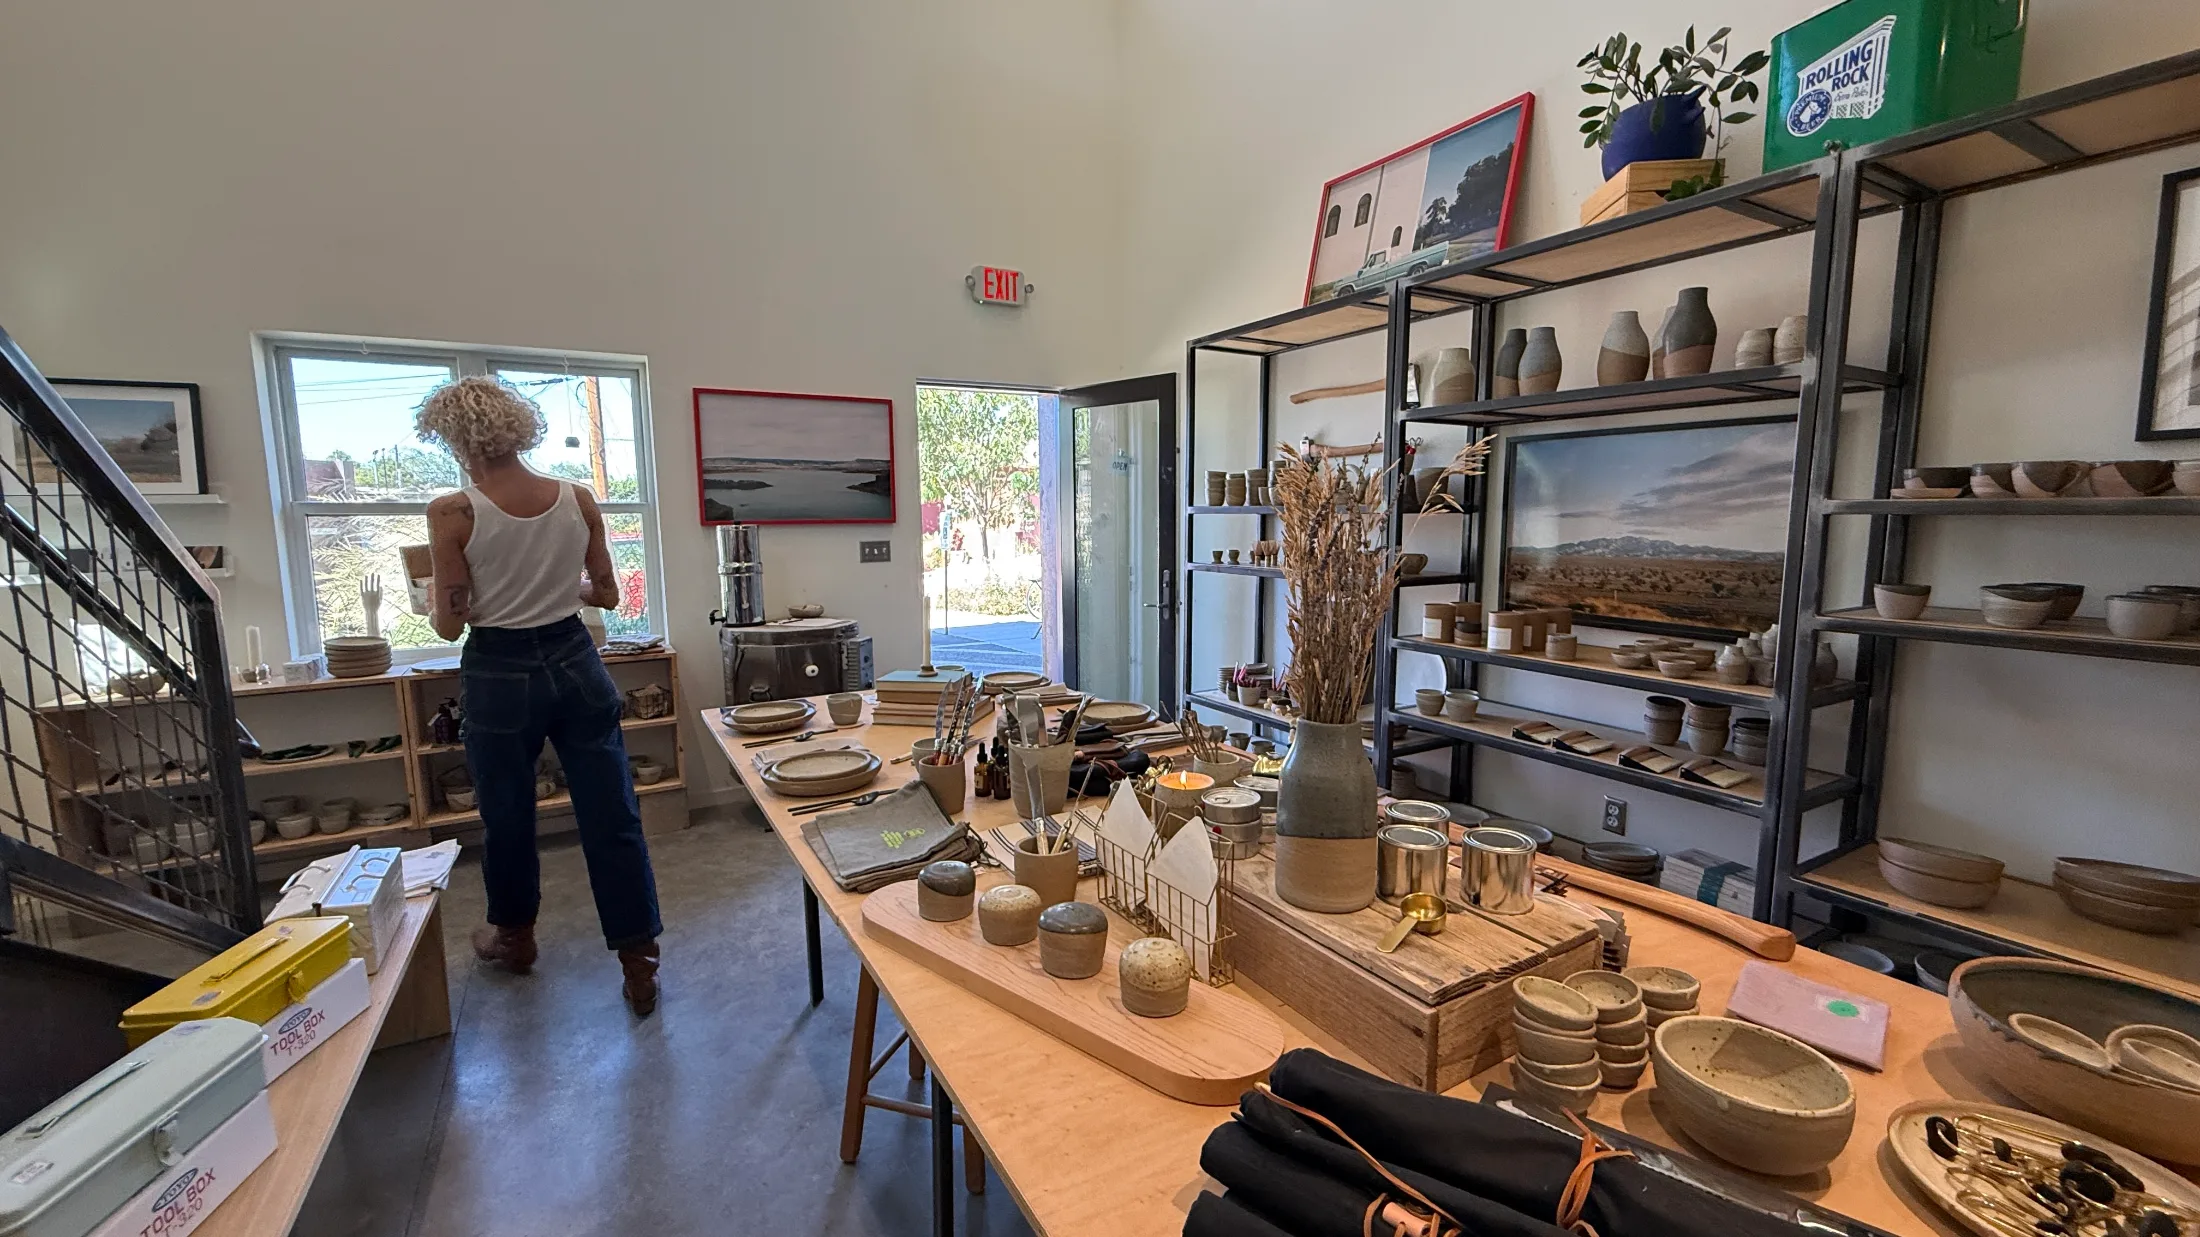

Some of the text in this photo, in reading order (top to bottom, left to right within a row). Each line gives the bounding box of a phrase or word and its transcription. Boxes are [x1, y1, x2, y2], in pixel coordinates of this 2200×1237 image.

[1805, 39, 1874, 90] ROLLING
[1831, 62, 1870, 92] ROCK
[984, 267, 1019, 302] EXIT
[270, 1009, 326, 1056] TOOL BOX
[286, 1029, 316, 1056] T-320
[140, 1167, 217, 1237] TOOL BOX
[162, 1175, 191, 1202] TOYO
[162, 1197, 203, 1237] T-320
